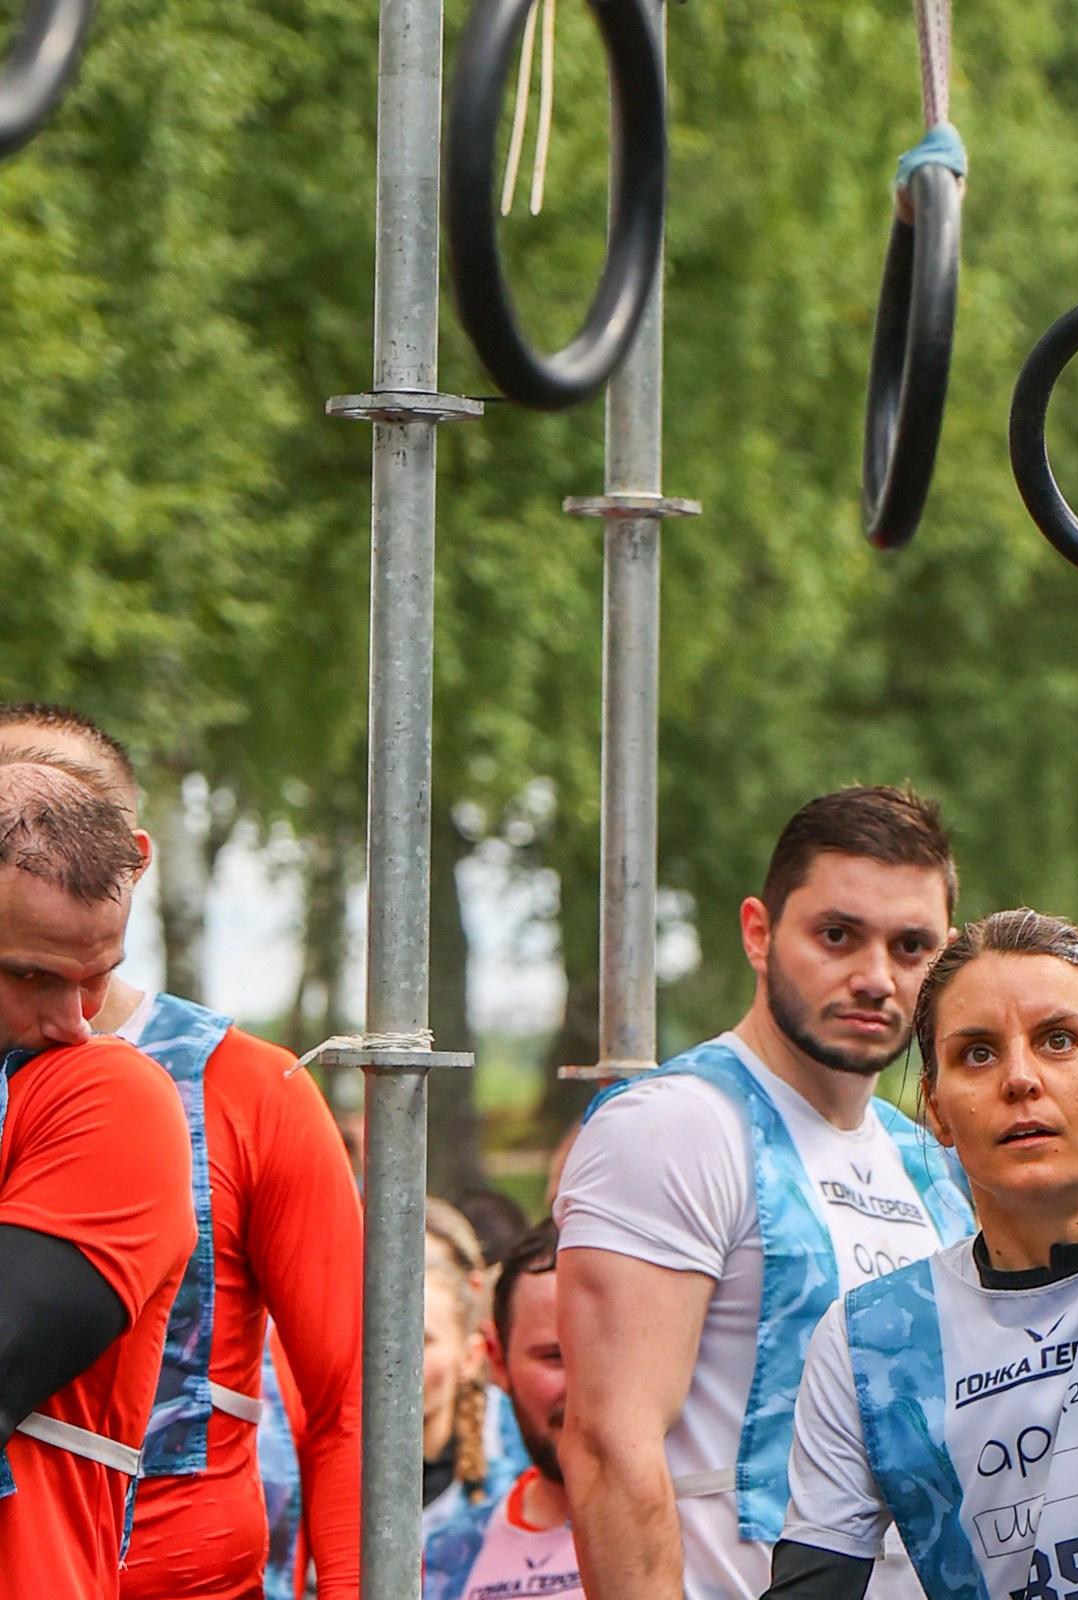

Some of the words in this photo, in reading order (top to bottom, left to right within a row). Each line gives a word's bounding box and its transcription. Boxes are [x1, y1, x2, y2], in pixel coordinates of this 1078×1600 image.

[820, 1180, 866, 1210] ГОНКА
[869, 1196, 923, 1220] ГЕРОЕВ
[955, 1357, 1031, 1401] ГОНКА
